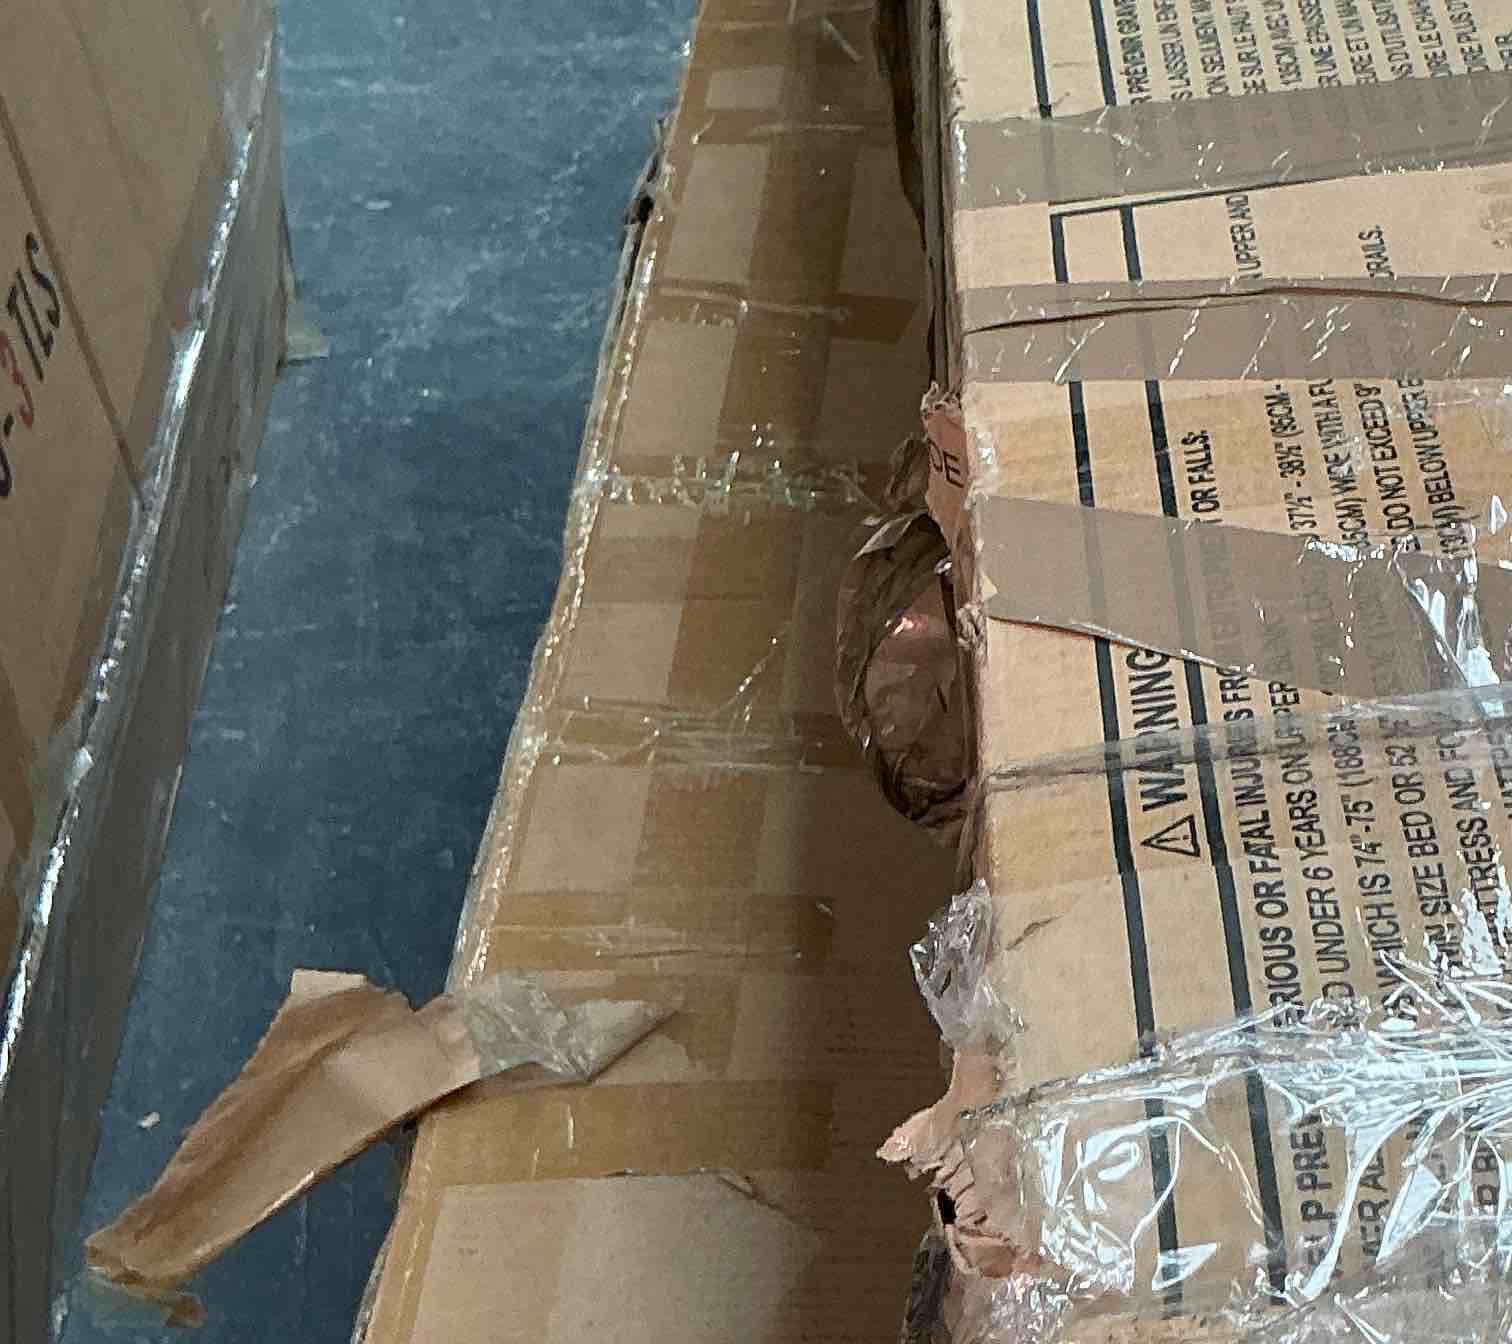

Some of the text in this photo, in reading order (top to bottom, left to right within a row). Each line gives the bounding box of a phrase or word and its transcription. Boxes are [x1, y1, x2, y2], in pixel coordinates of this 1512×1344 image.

[1181, 430, 1216, 485] FALLS:
[1190, 486, 1220, 513] OR
[1374, 464, 1409, 500] NOT
[1282, 752, 1313, 785] ON
[1392, 773, 1426, 805] OR
[1236, 809, 1280, 874] FATAL
[1284, 789, 1329, 861] YEARS
[1399, 811, 1441, 858] BED
[1303, 865, 1334, 881] 6
[1358, 874, 1393, 897] IS
[1412, 862, 1452, 917] SIZE
[1254, 879, 1290, 919] OR
[1306, 888, 1348, 975] UNDER
